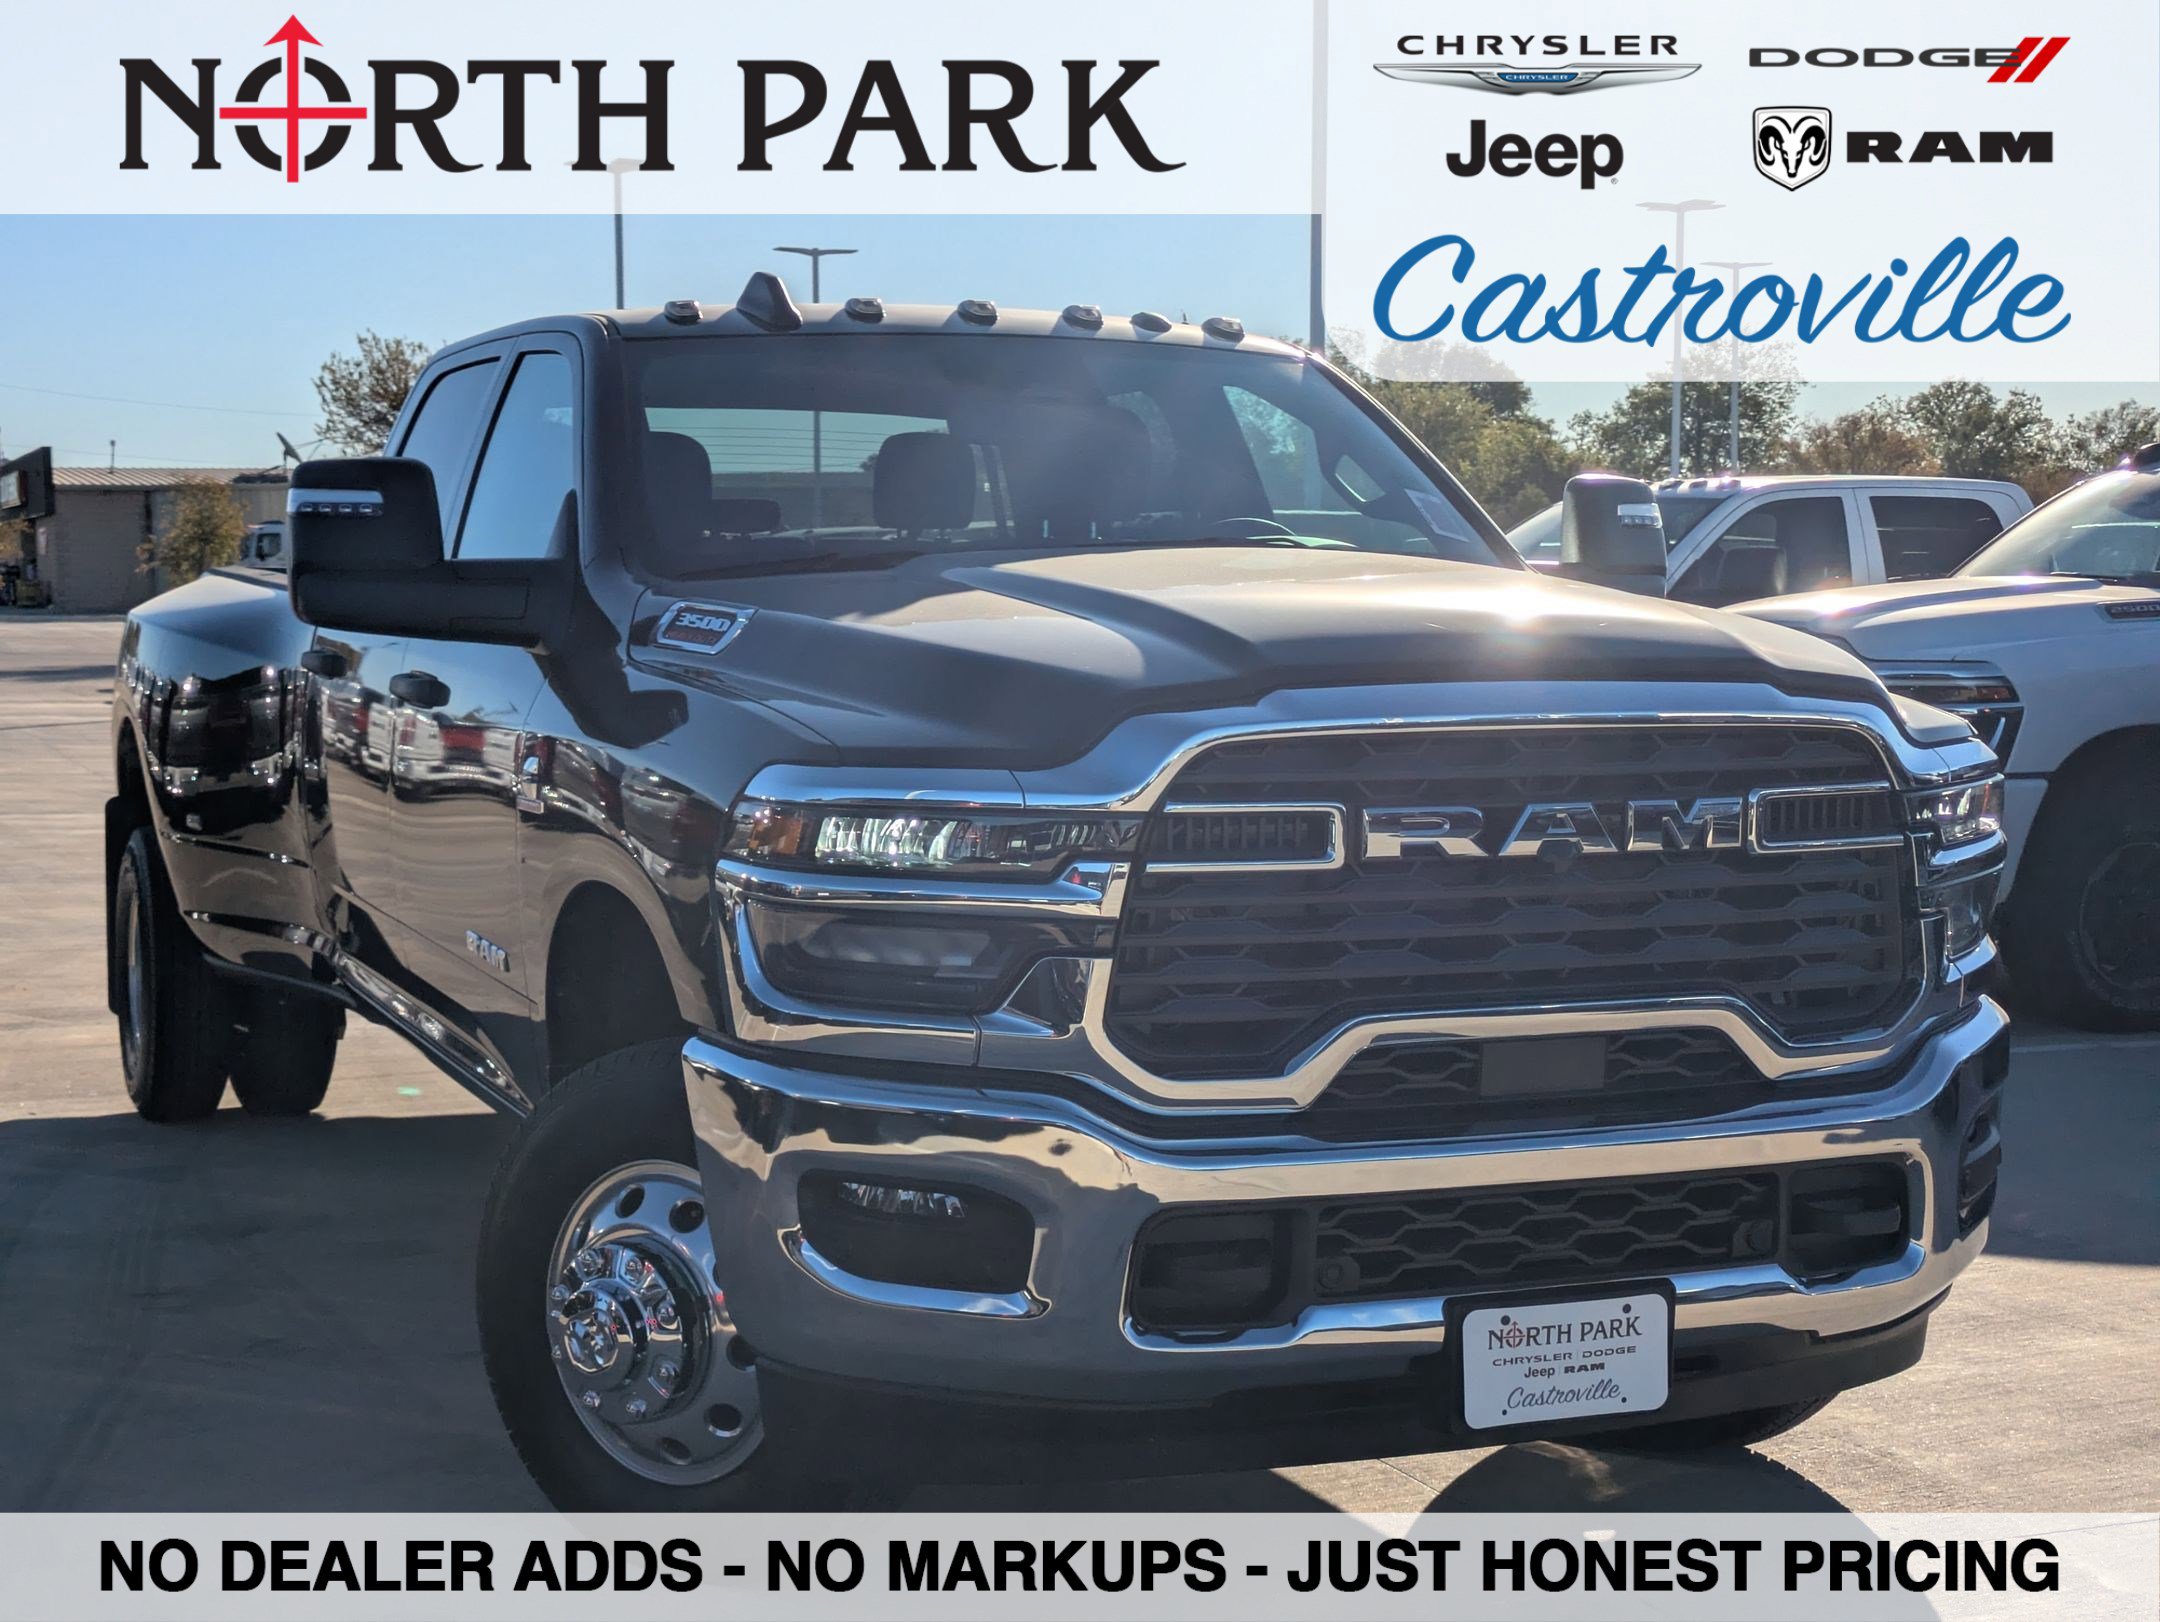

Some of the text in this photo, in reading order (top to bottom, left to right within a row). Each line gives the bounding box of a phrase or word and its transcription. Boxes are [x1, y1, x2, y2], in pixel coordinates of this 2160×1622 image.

[675, 612, 732, 632] 3500
[1362, 797, 1743, 859] RAM
[465, 929, 510, 973] RAM
[1488, 1316, 1643, 1350] NORTH PARK
[1492, 1345, 1637, 1367] CHRYSLER DODGE
[1524, 1362, 1605, 1379] Jeep RAM
[1507, 1378, 1621, 1409] Castroville
